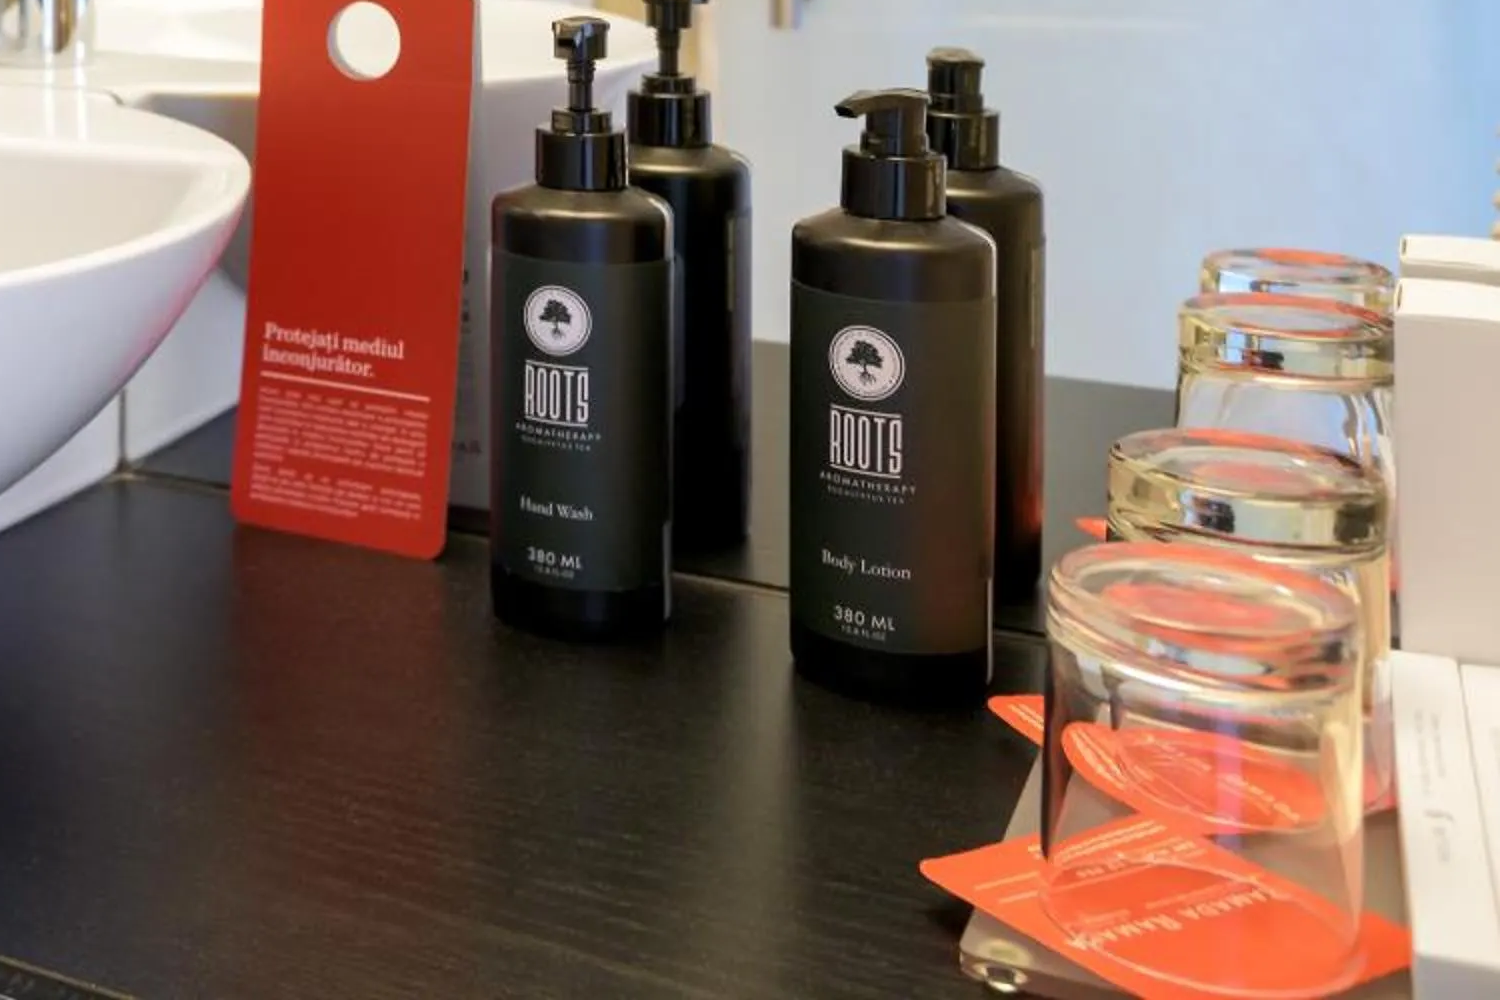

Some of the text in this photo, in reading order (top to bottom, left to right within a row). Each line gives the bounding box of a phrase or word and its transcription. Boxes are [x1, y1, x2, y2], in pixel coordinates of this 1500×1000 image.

[343, 335, 404, 359] mediul
[525, 363, 589, 423] ROOTS
[830, 409, 902, 474] ROOTS
[819, 470, 916, 496] AROMATHERAPY
[520, 494, 593, 521] Hand Wash
[527, 546, 582, 570] 380 ML
[821, 548, 912, 580] Body Lotion
[834, 604, 896, 632] 380 ML
